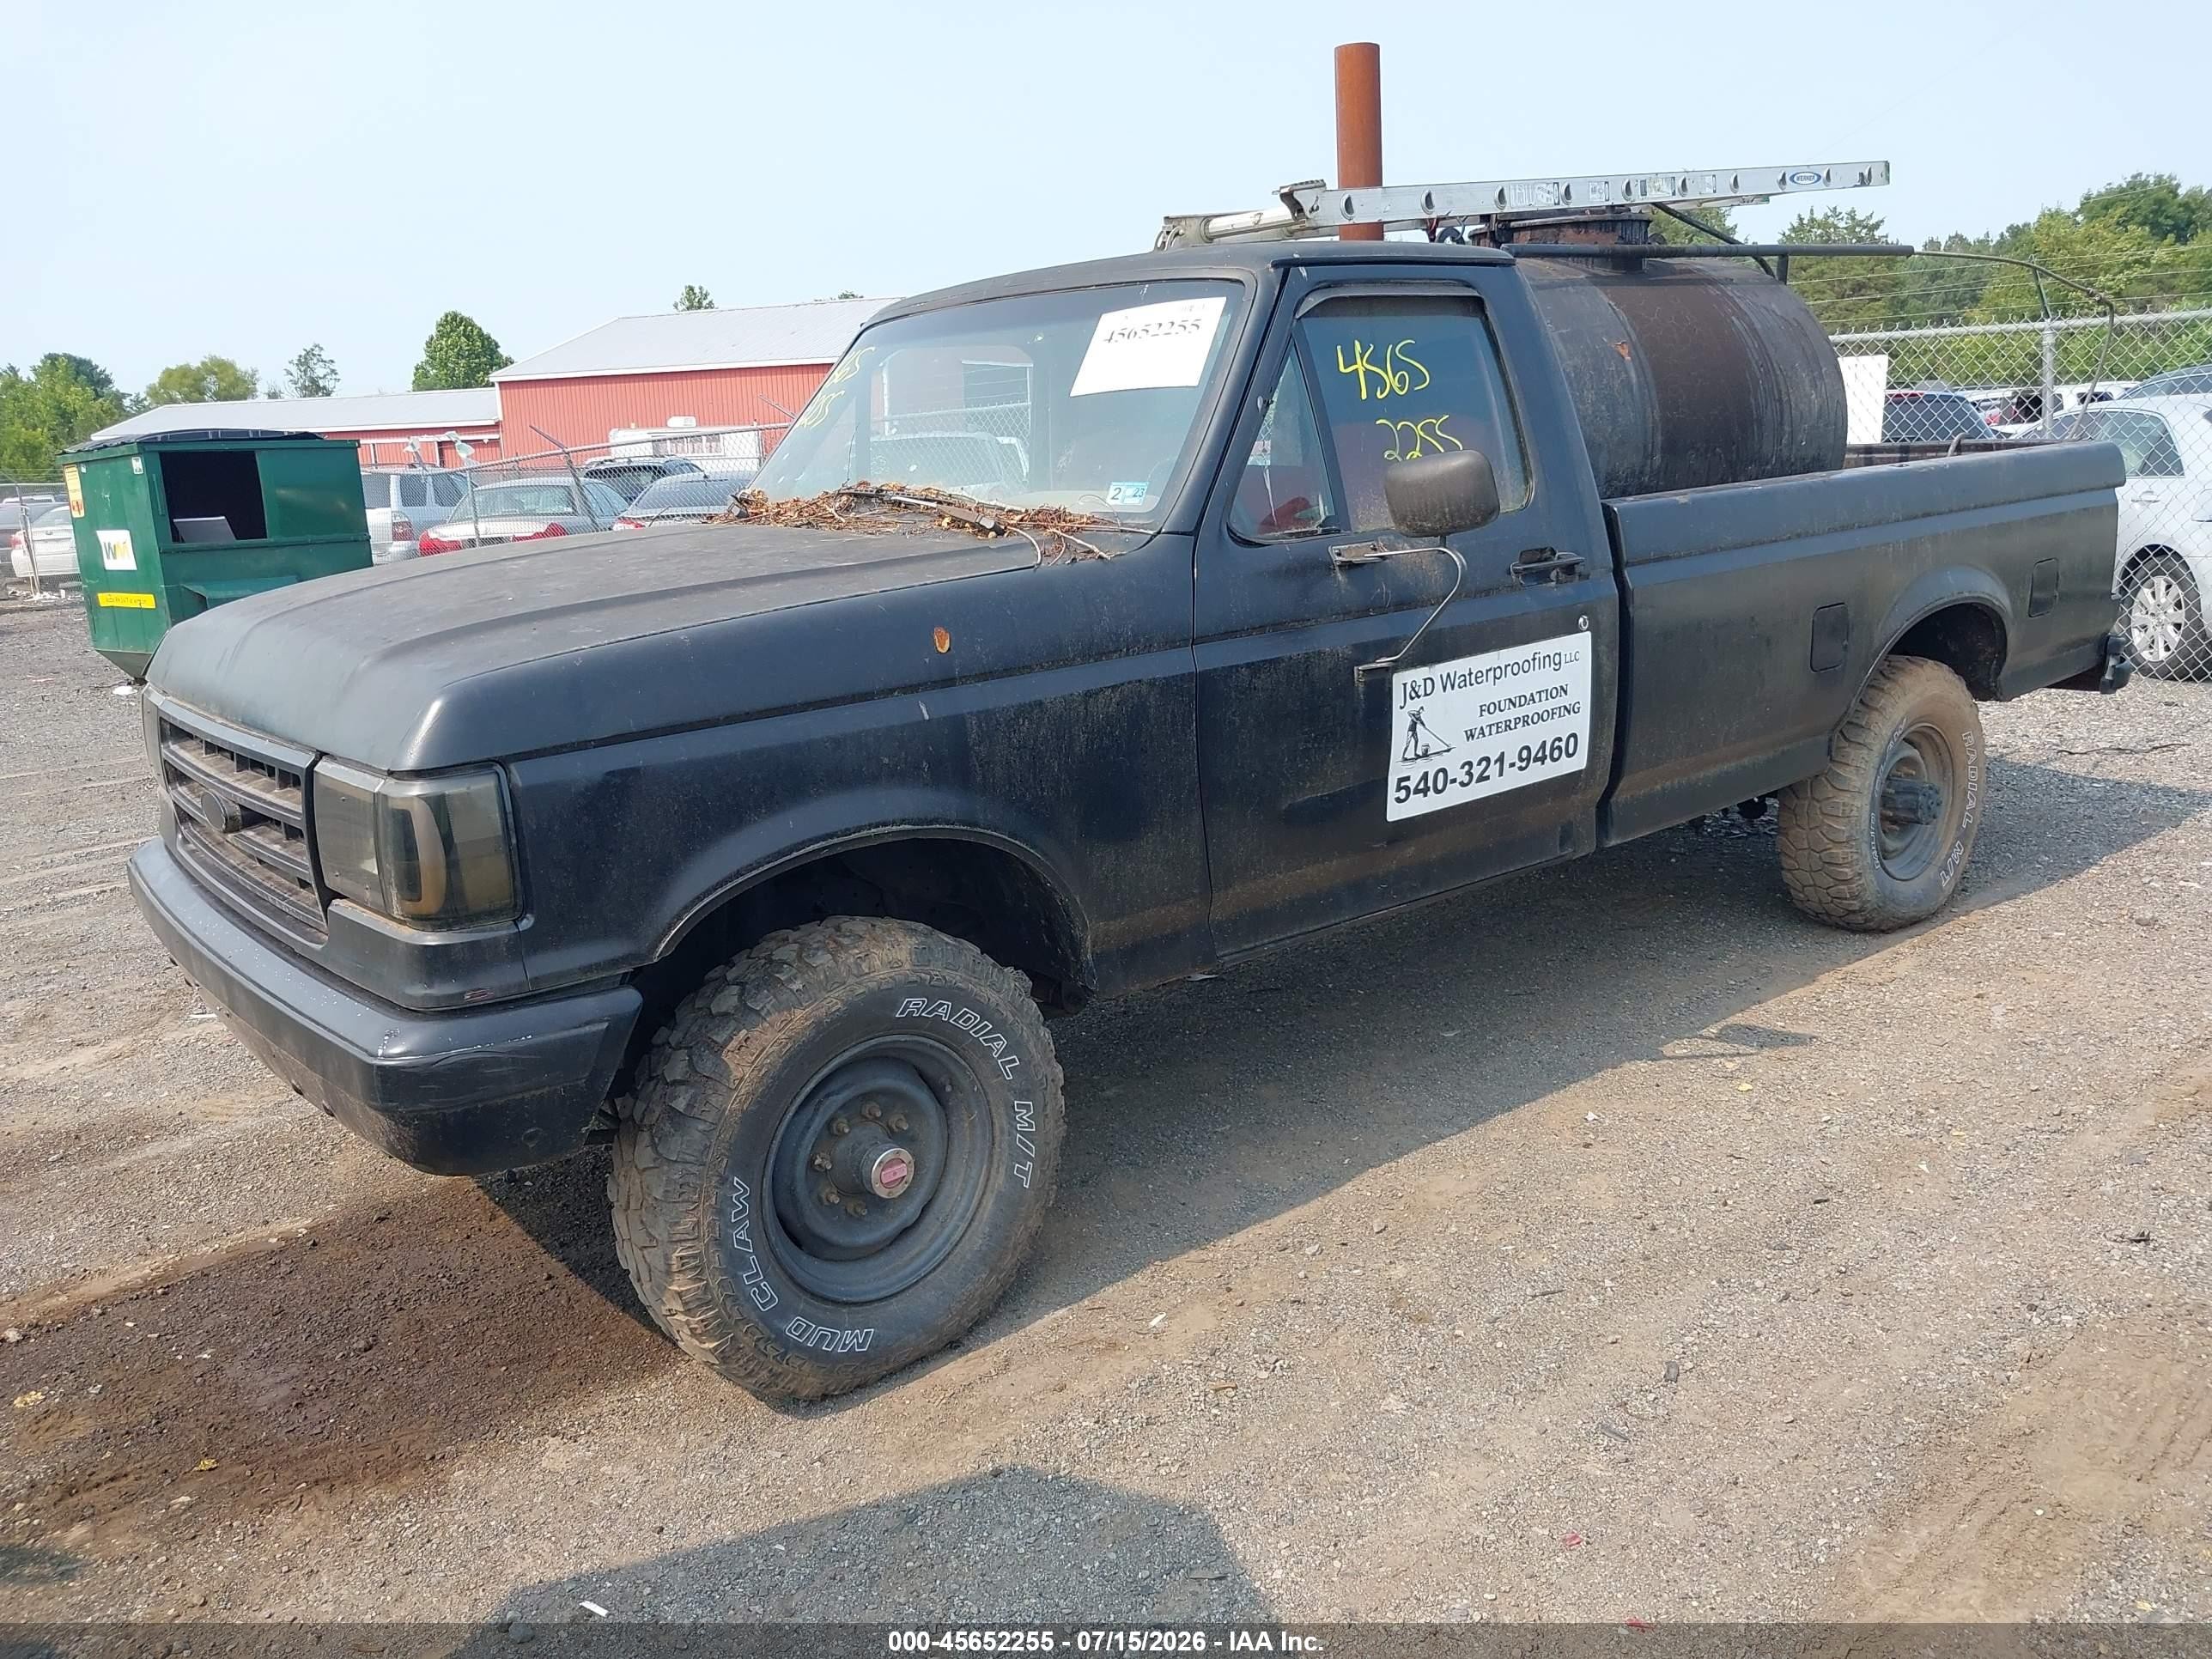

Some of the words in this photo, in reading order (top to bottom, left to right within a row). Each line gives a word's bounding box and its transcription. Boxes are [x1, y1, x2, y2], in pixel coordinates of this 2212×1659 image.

[1336, 339, 1430, 400] 4565
[1111, 487, 1122, 501] 2
[1133, 487, 1146, 498] 23
[103, 540, 129, 561] WM
[1399, 676, 1436, 710] J&D
[1439, 650, 1563, 694] Waterproofing
[1564, 650, 1581, 665] LLC
[1478, 684, 1570, 718] FOUNDATION
[1462, 701, 1582, 744] WATERPROOFING
[1393, 732, 1579, 805] 540-321-9460
[1962, 731, 1978, 830] RADIAL
[1938, 840, 1966, 887] M/T
[895, 997, 1020, 1080] RADIAL
[1013, 1100, 1036, 1188] M/T
[731, 1176, 779, 1312] CLAW
[785, 1316, 874, 1353] MUD
